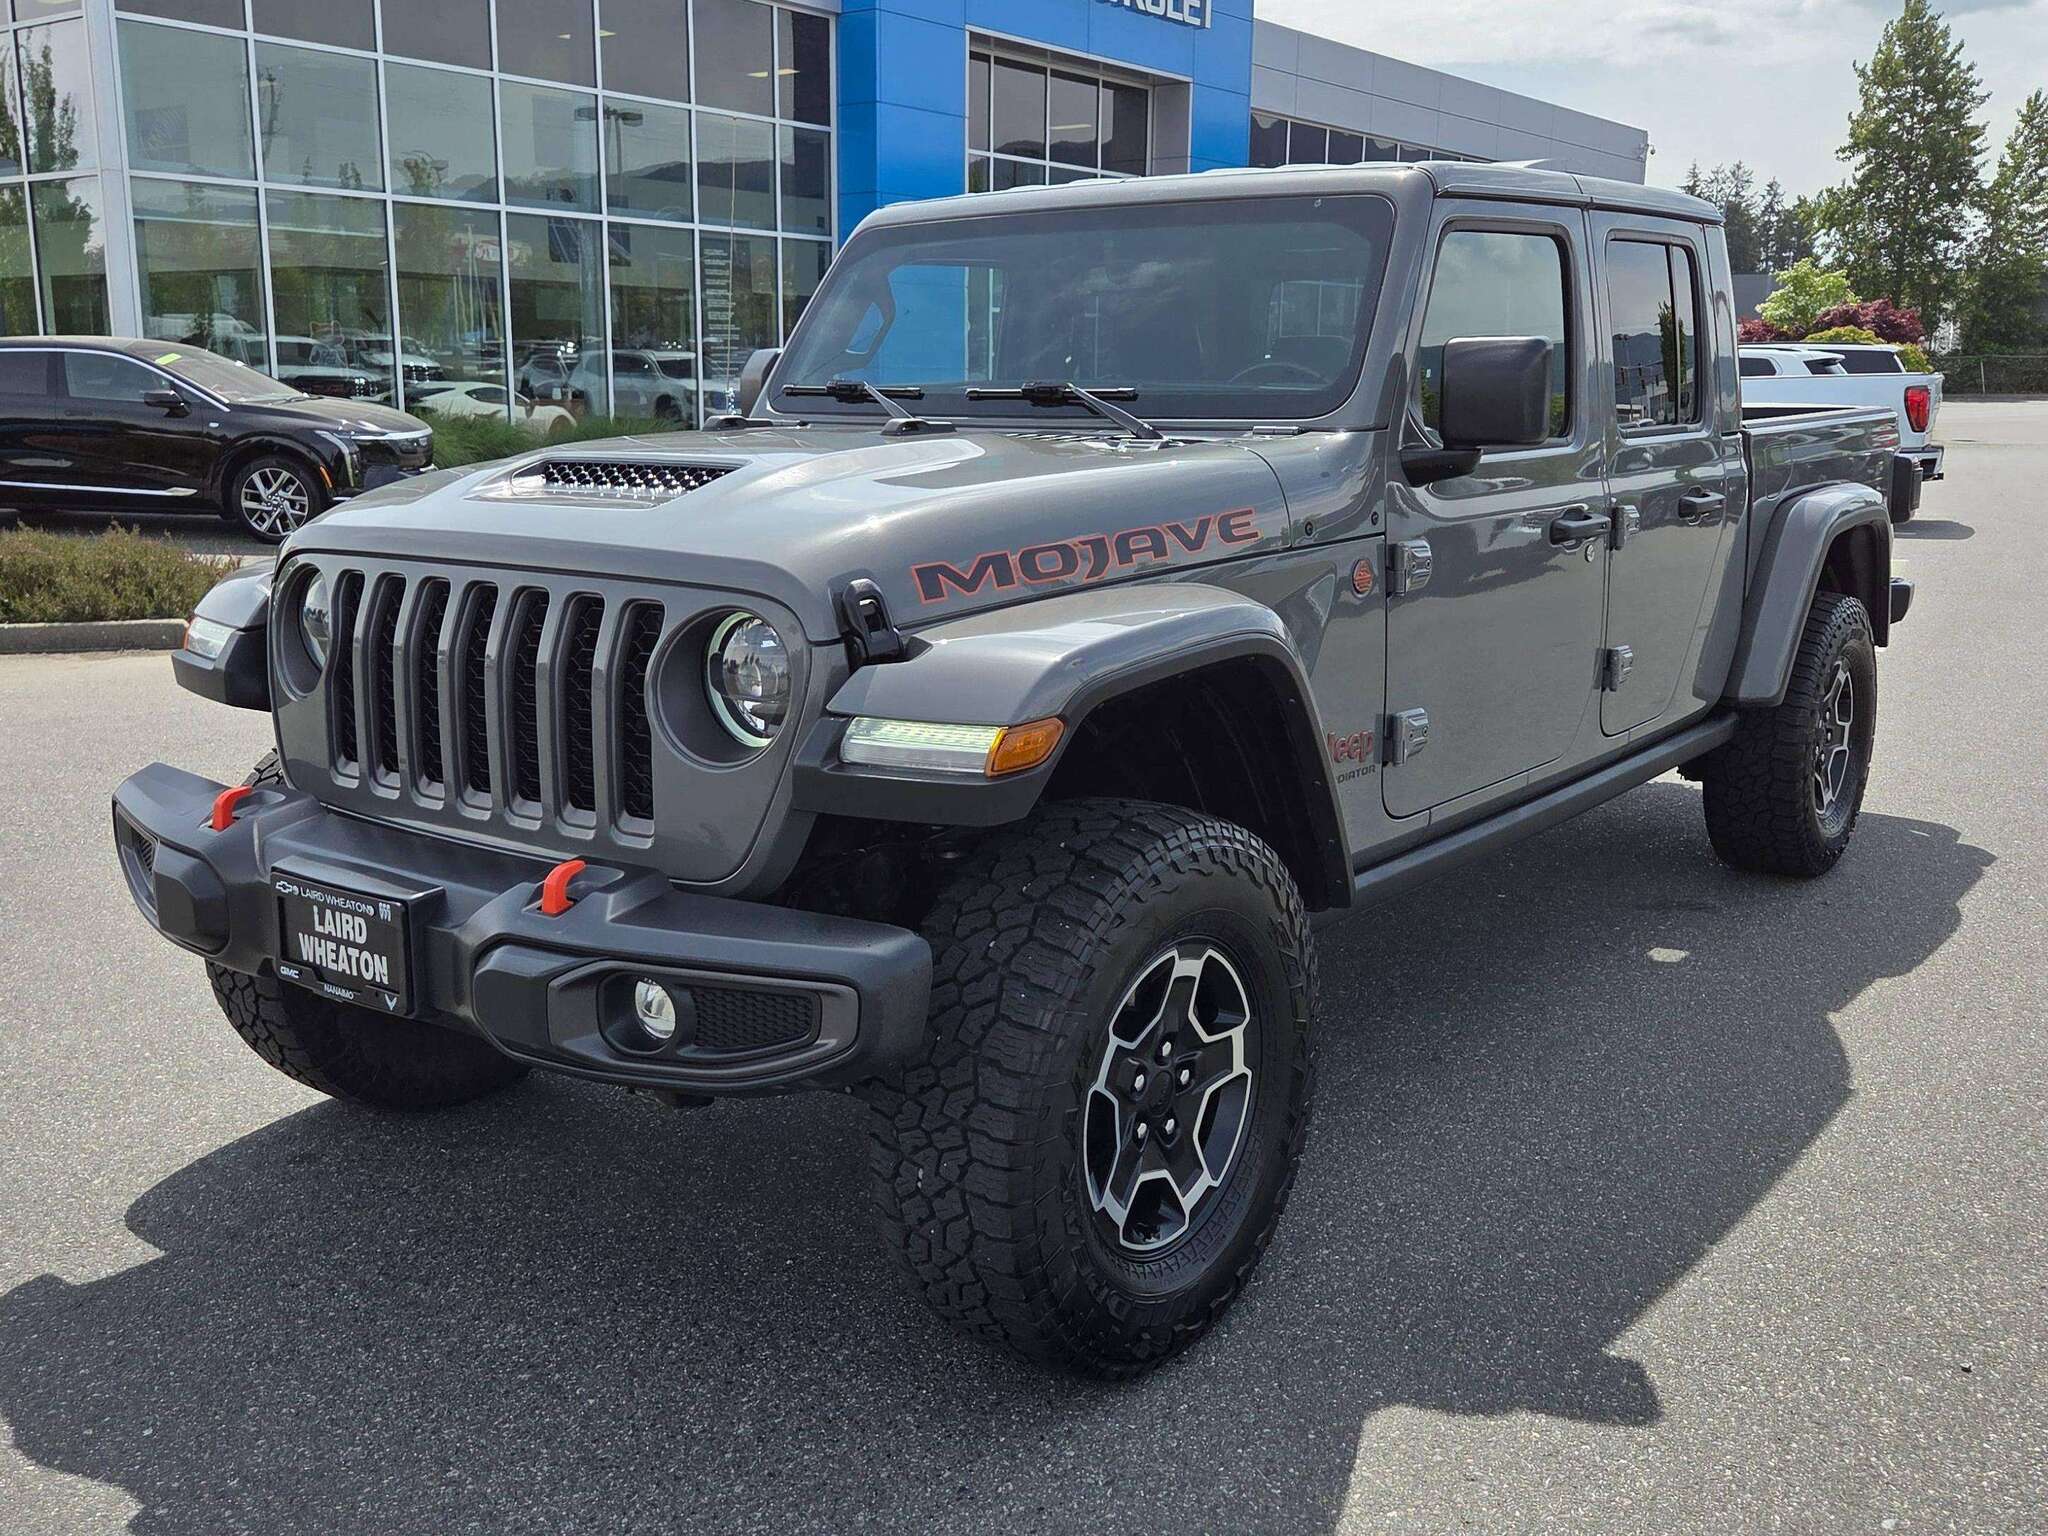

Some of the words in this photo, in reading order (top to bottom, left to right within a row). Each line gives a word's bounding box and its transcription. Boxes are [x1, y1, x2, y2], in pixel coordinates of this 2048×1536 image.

[911, 508, 1263, 605] MOJAVE
[300, 887, 324, 902] LAIRD
[325, 894, 372, 915] WHEATON
[313, 905, 367, 944] LAIRD
[280, 966, 299, 979] GMC
[299, 932, 389, 985] WHEATON
